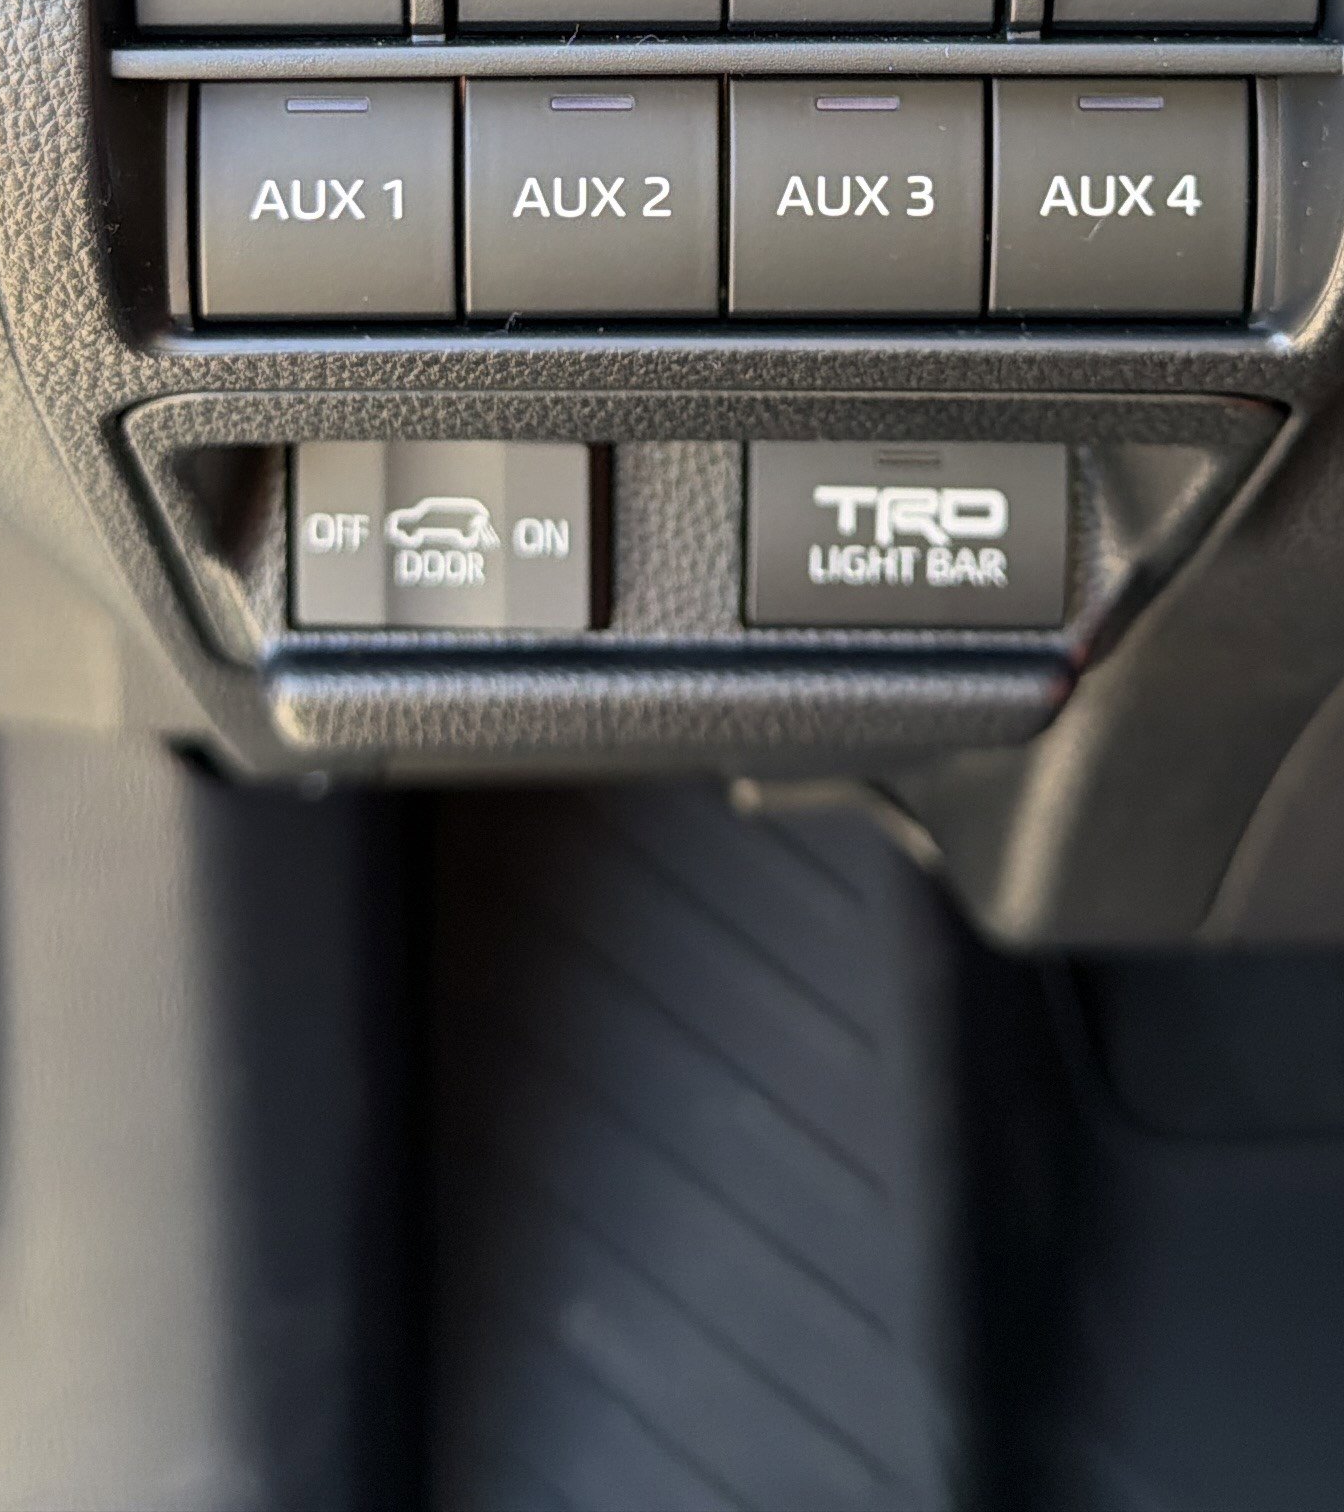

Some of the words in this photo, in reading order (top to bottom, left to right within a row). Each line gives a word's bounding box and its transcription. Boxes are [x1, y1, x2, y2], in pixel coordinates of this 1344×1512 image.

[250, 178, 366, 221] AUX
[382, 178, 404, 220] 1
[512, 176, 627, 218] AUX
[642, 176, 672, 217] 2
[775, 175, 890, 217] AUX
[905, 175, 935, 217] 3
[1039, 175, 1156, 217] AUX
[1166, 175, 1203, 217] 4
[306, 512, 370, 554] OFF
[813, 485, 1009, 546] TRD
[512, 517, 570, 560] ON
[394, 549, 486, 587] DOOR
[809, 544, 920, 586] LIGHT
[926, 546, 1009, 588] BAR
